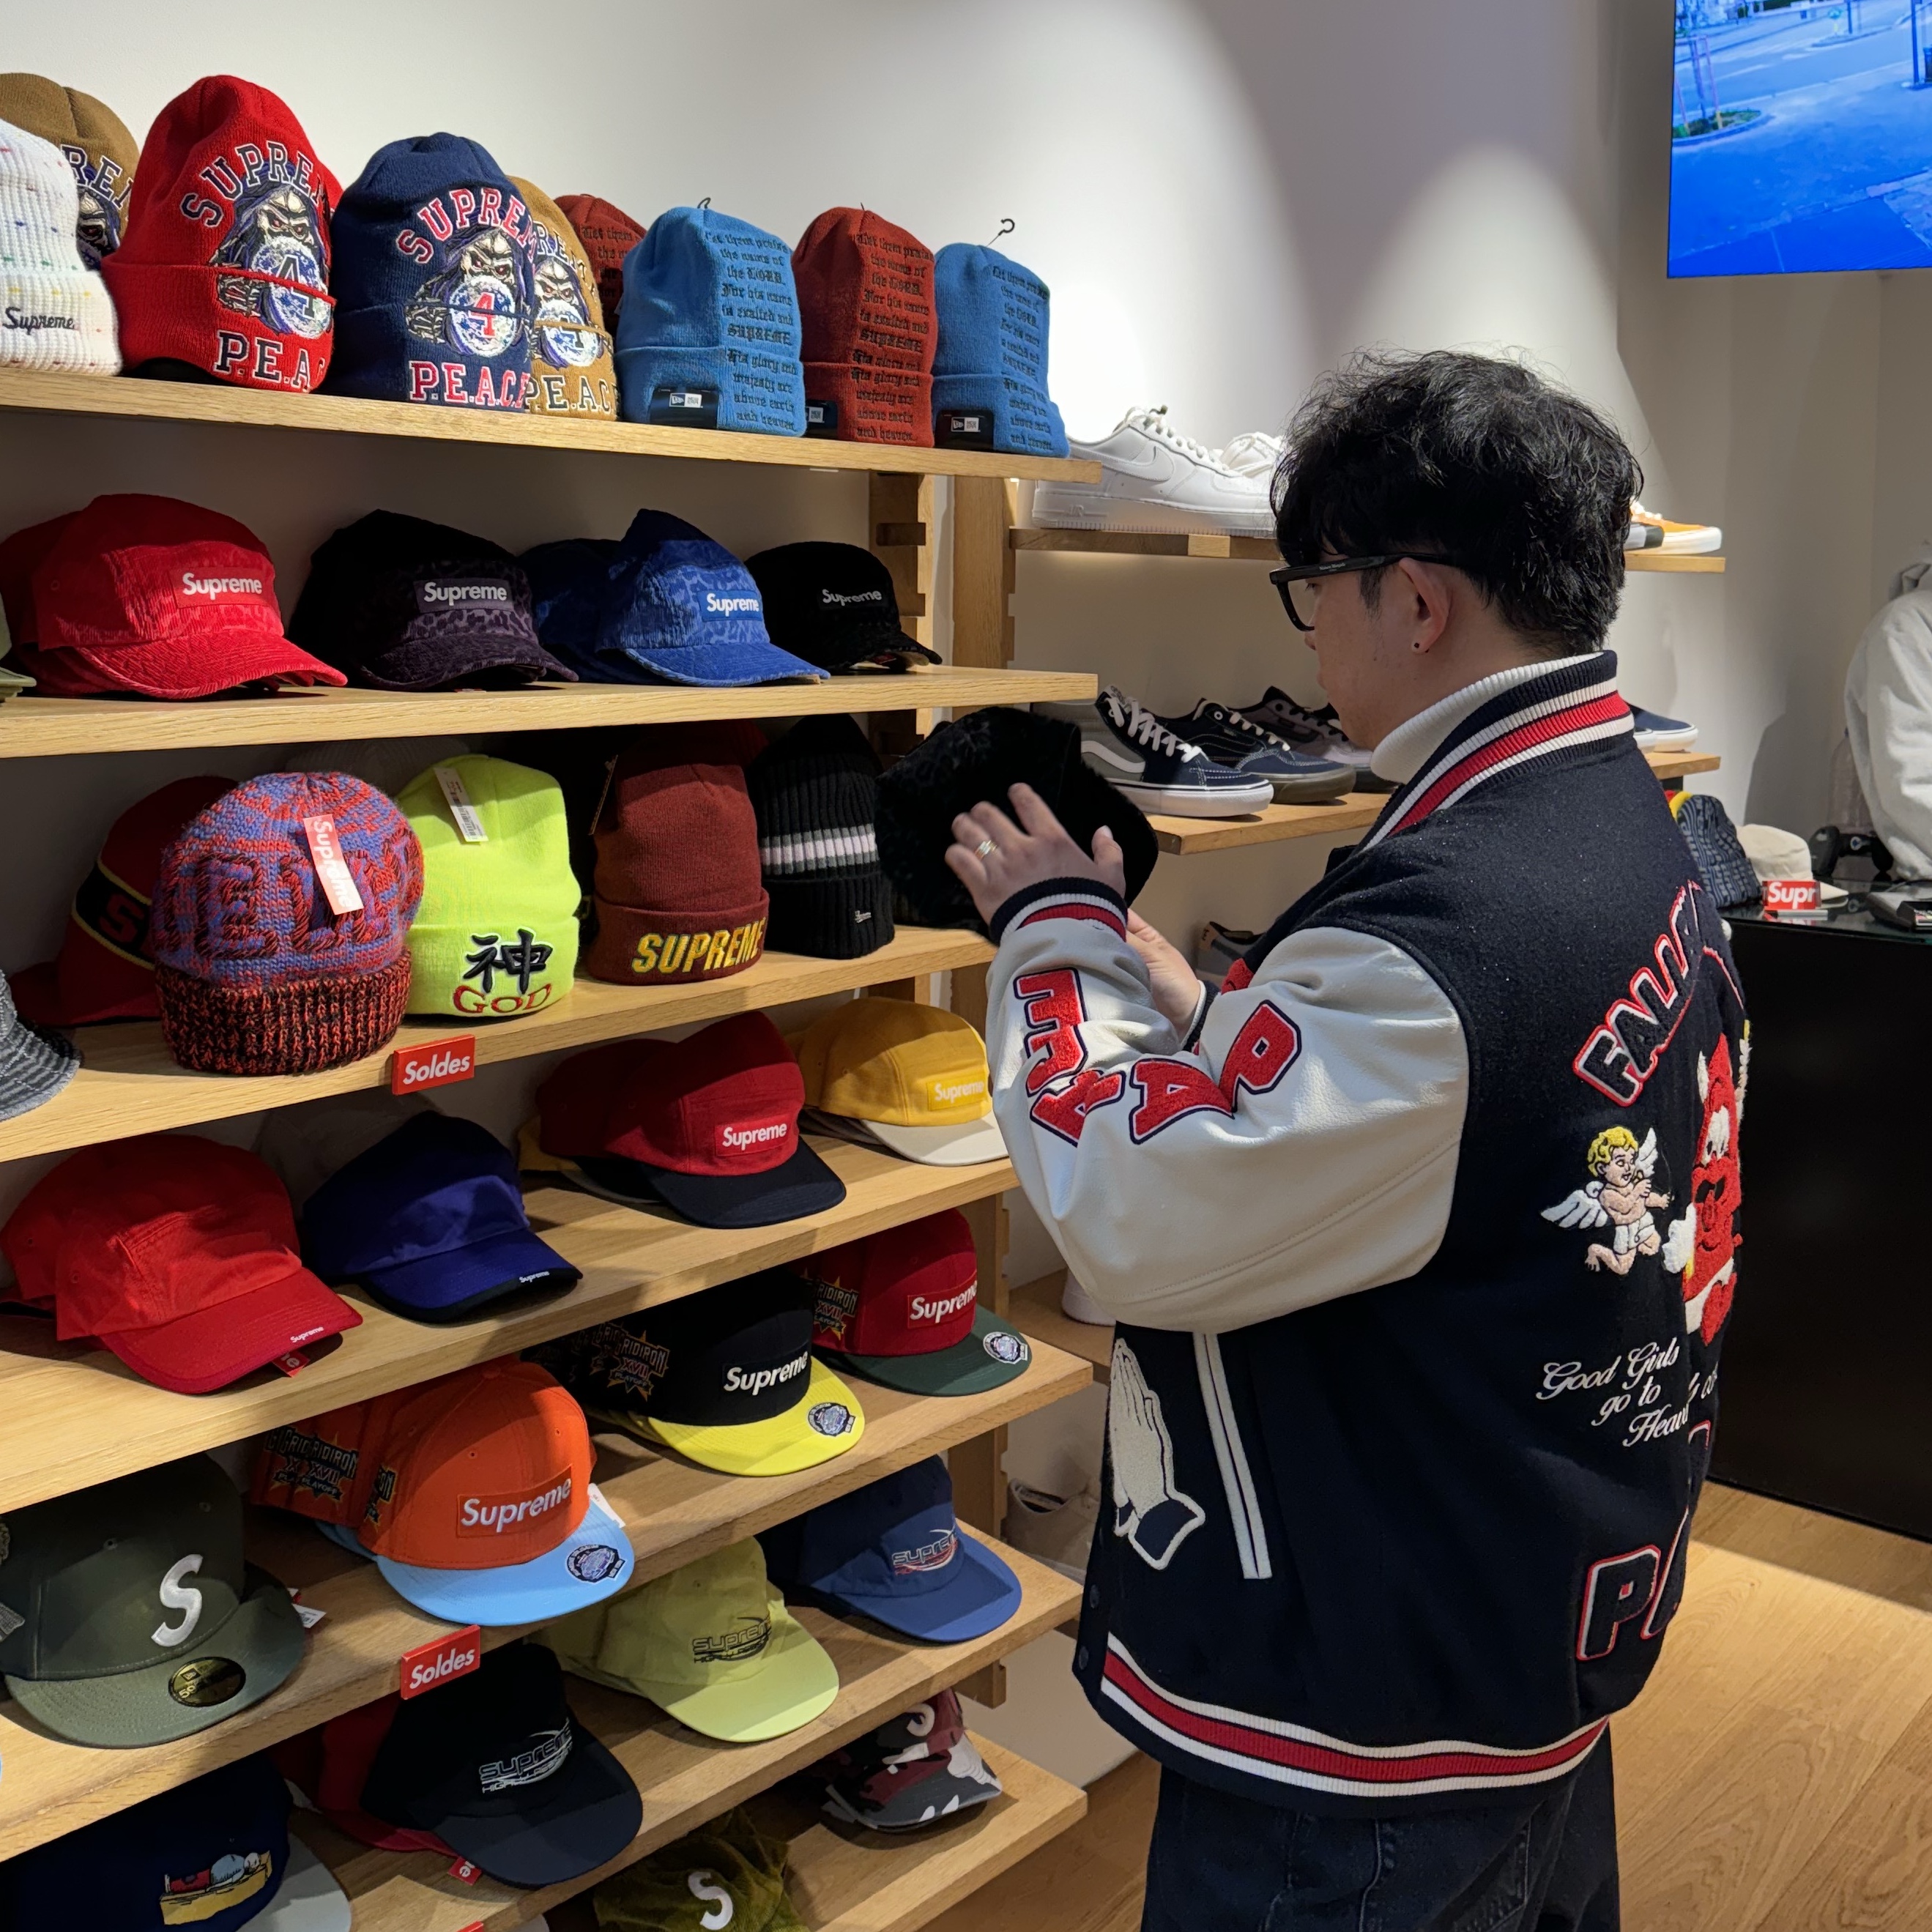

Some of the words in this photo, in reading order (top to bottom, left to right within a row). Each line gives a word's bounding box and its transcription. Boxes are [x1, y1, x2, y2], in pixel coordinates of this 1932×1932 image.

[1, 306, 75, 335] Supreme
[182, 572, 263, 600] Supreme
[423, 581, 508, 606] Supreme
[706, 592, 759, 617] Supreme
[822, 588, 883, 606] Supreme
[311, 818, 354, 910] Supreme
[462, 927, 554, 995] 神
[631, 915, 768, 976] SUPREME
[402, 1050, 471, 1085] Soldes
[934, 1079, 984, 1103] Supreme
[721, 1123, 788, 1151] Supreme
[519, 1270, 550, 1285] Supreme
[723, 1350, 809, 1396] Supreme
[1535, 1356, 1622, 1400] Good
[1621, 1337, 1680, 1391] Girls
[1591, 1394, 1632, 1427] go
[1638, 1375, 1662, 1407] to
[461, 1477, 572, 1533] Supreme
[151, 1553, 204, 1647] S
[409, 1647, 476, 1690] Soldes
[687, 1870, 734, 1931] S
